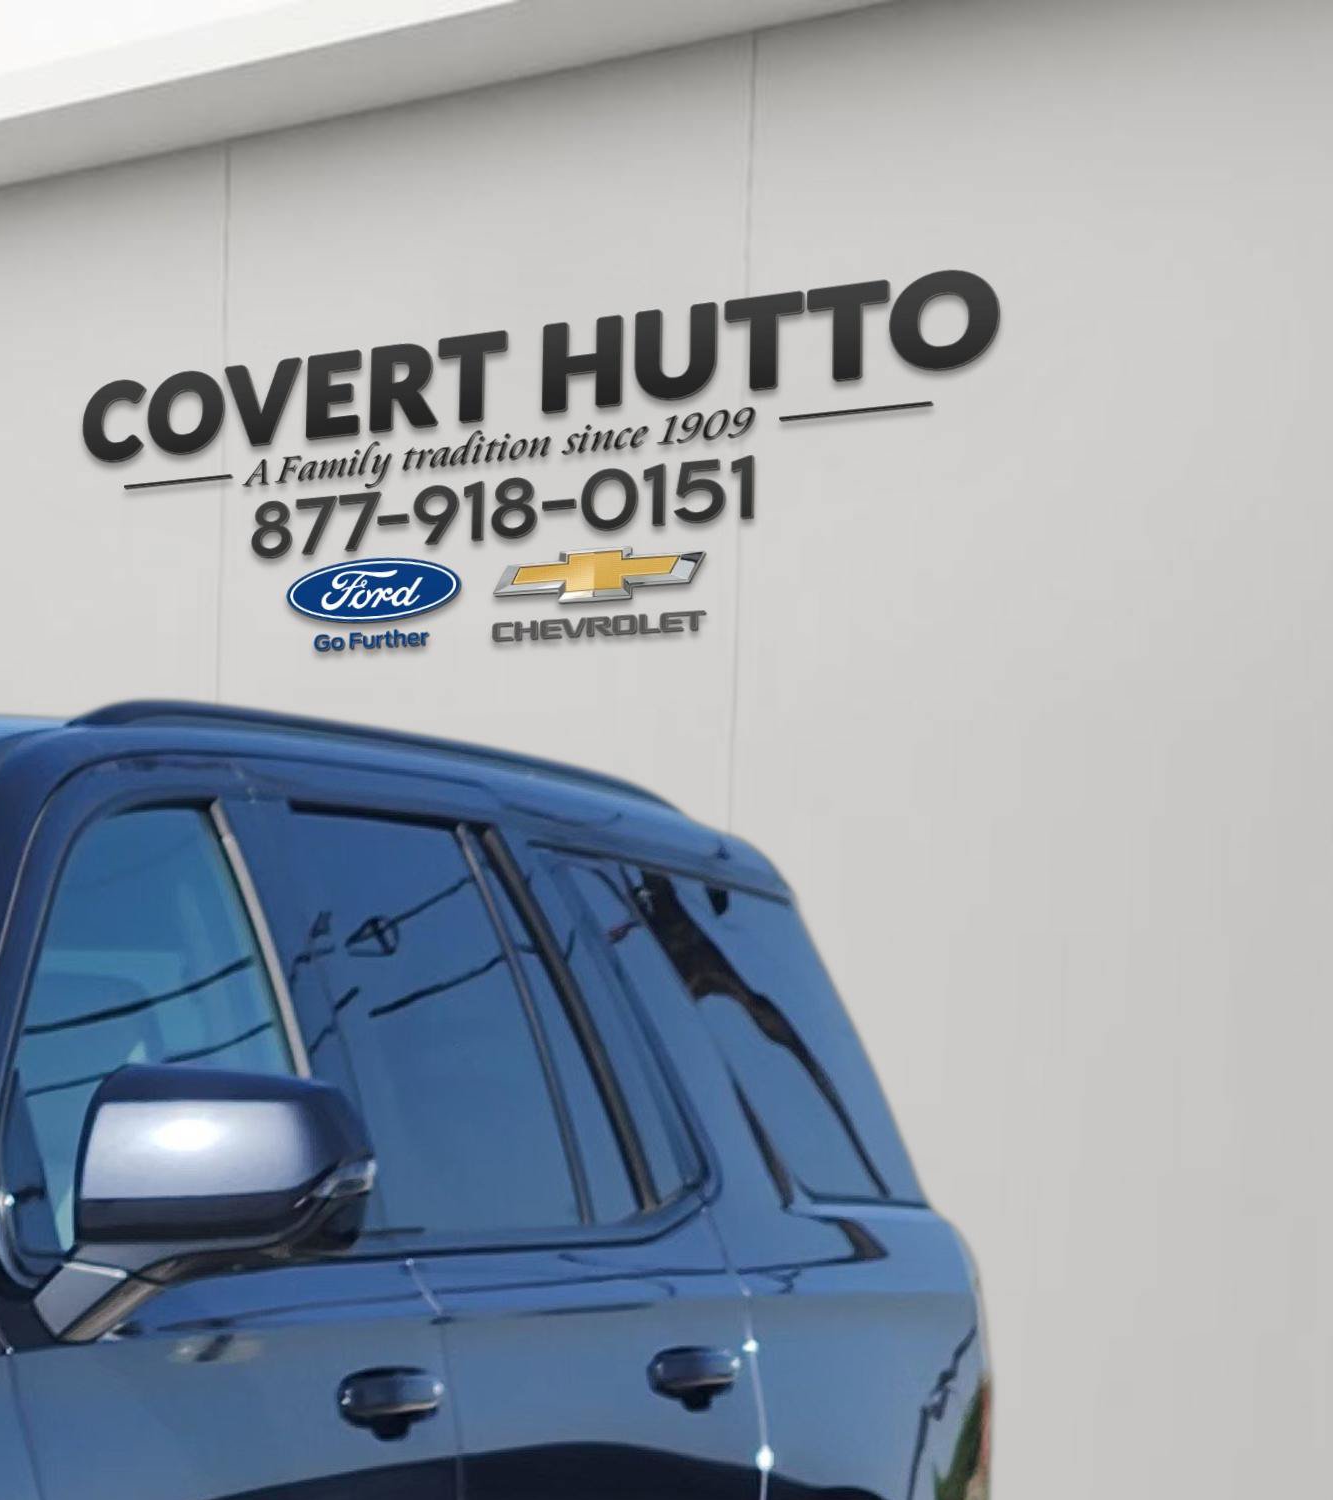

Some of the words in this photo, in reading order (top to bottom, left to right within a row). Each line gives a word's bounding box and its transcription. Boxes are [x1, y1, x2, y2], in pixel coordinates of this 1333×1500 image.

[82, 330, 508, 464] COVERT
[542, 269, 1001, 413] HUTTO
[242, 458, 269, 488] A
[275, 440, 393, 489] Family
[402, 430, 552, 472] tradition
[561, 424, 650, 456] since
[656, 406, 757, 446] 1909
[251, 455, 755, 559] 877-918-0151
[321, 569, 423, 610] Ford
[313, 633, 346, 653] Go
[349, 629, 430, 651] Further
[491, 609, 708, 644] CHEVROLET
